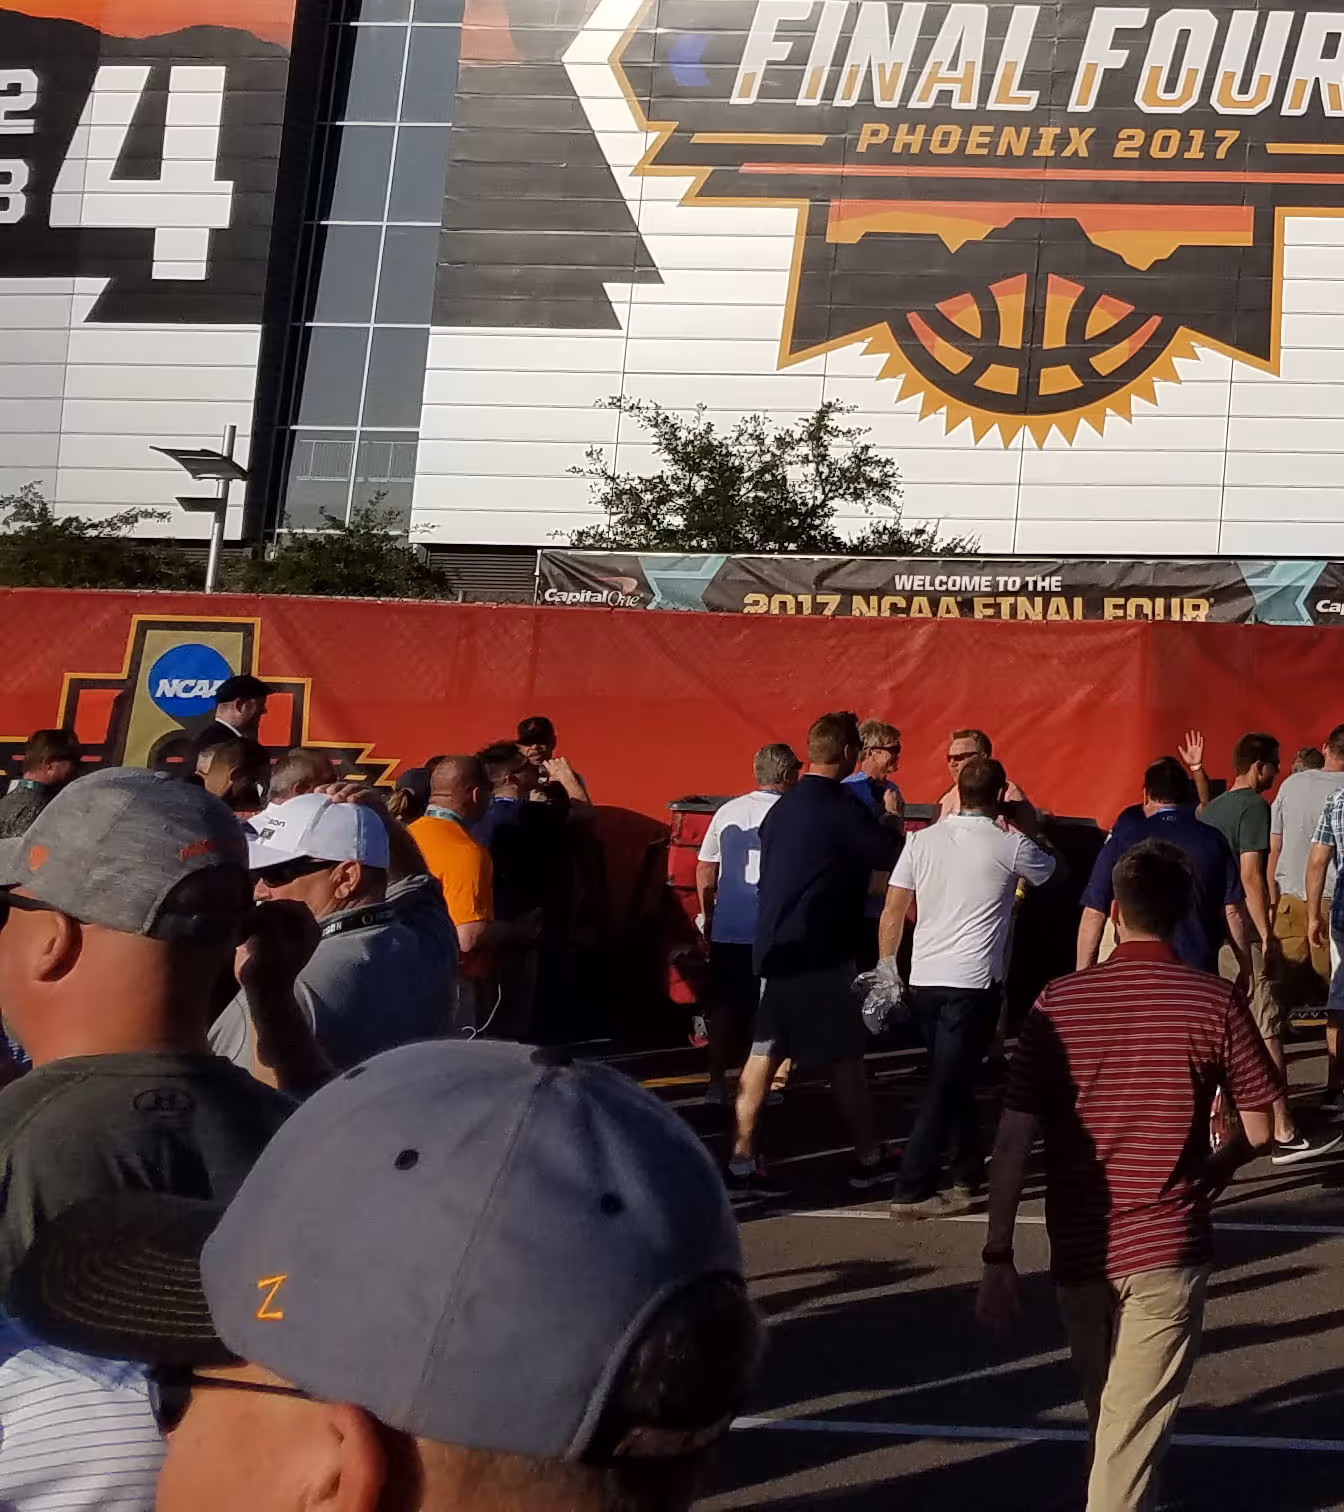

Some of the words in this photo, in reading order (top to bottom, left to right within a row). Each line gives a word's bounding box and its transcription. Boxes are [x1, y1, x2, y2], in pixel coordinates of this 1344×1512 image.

[855, 123, 1097, 160] PHOENIX
[1113, 127, 1242, 161] 2017
[49, 65, 234, 281] 4
[894, 574, 992, 591] WELCOME
[996, 575, 1020, 592] TO
[1024, 575, 1063, 593] THE
[743, 593, 842, 615] 2017
[851, 595, 962, 618] NCAA
